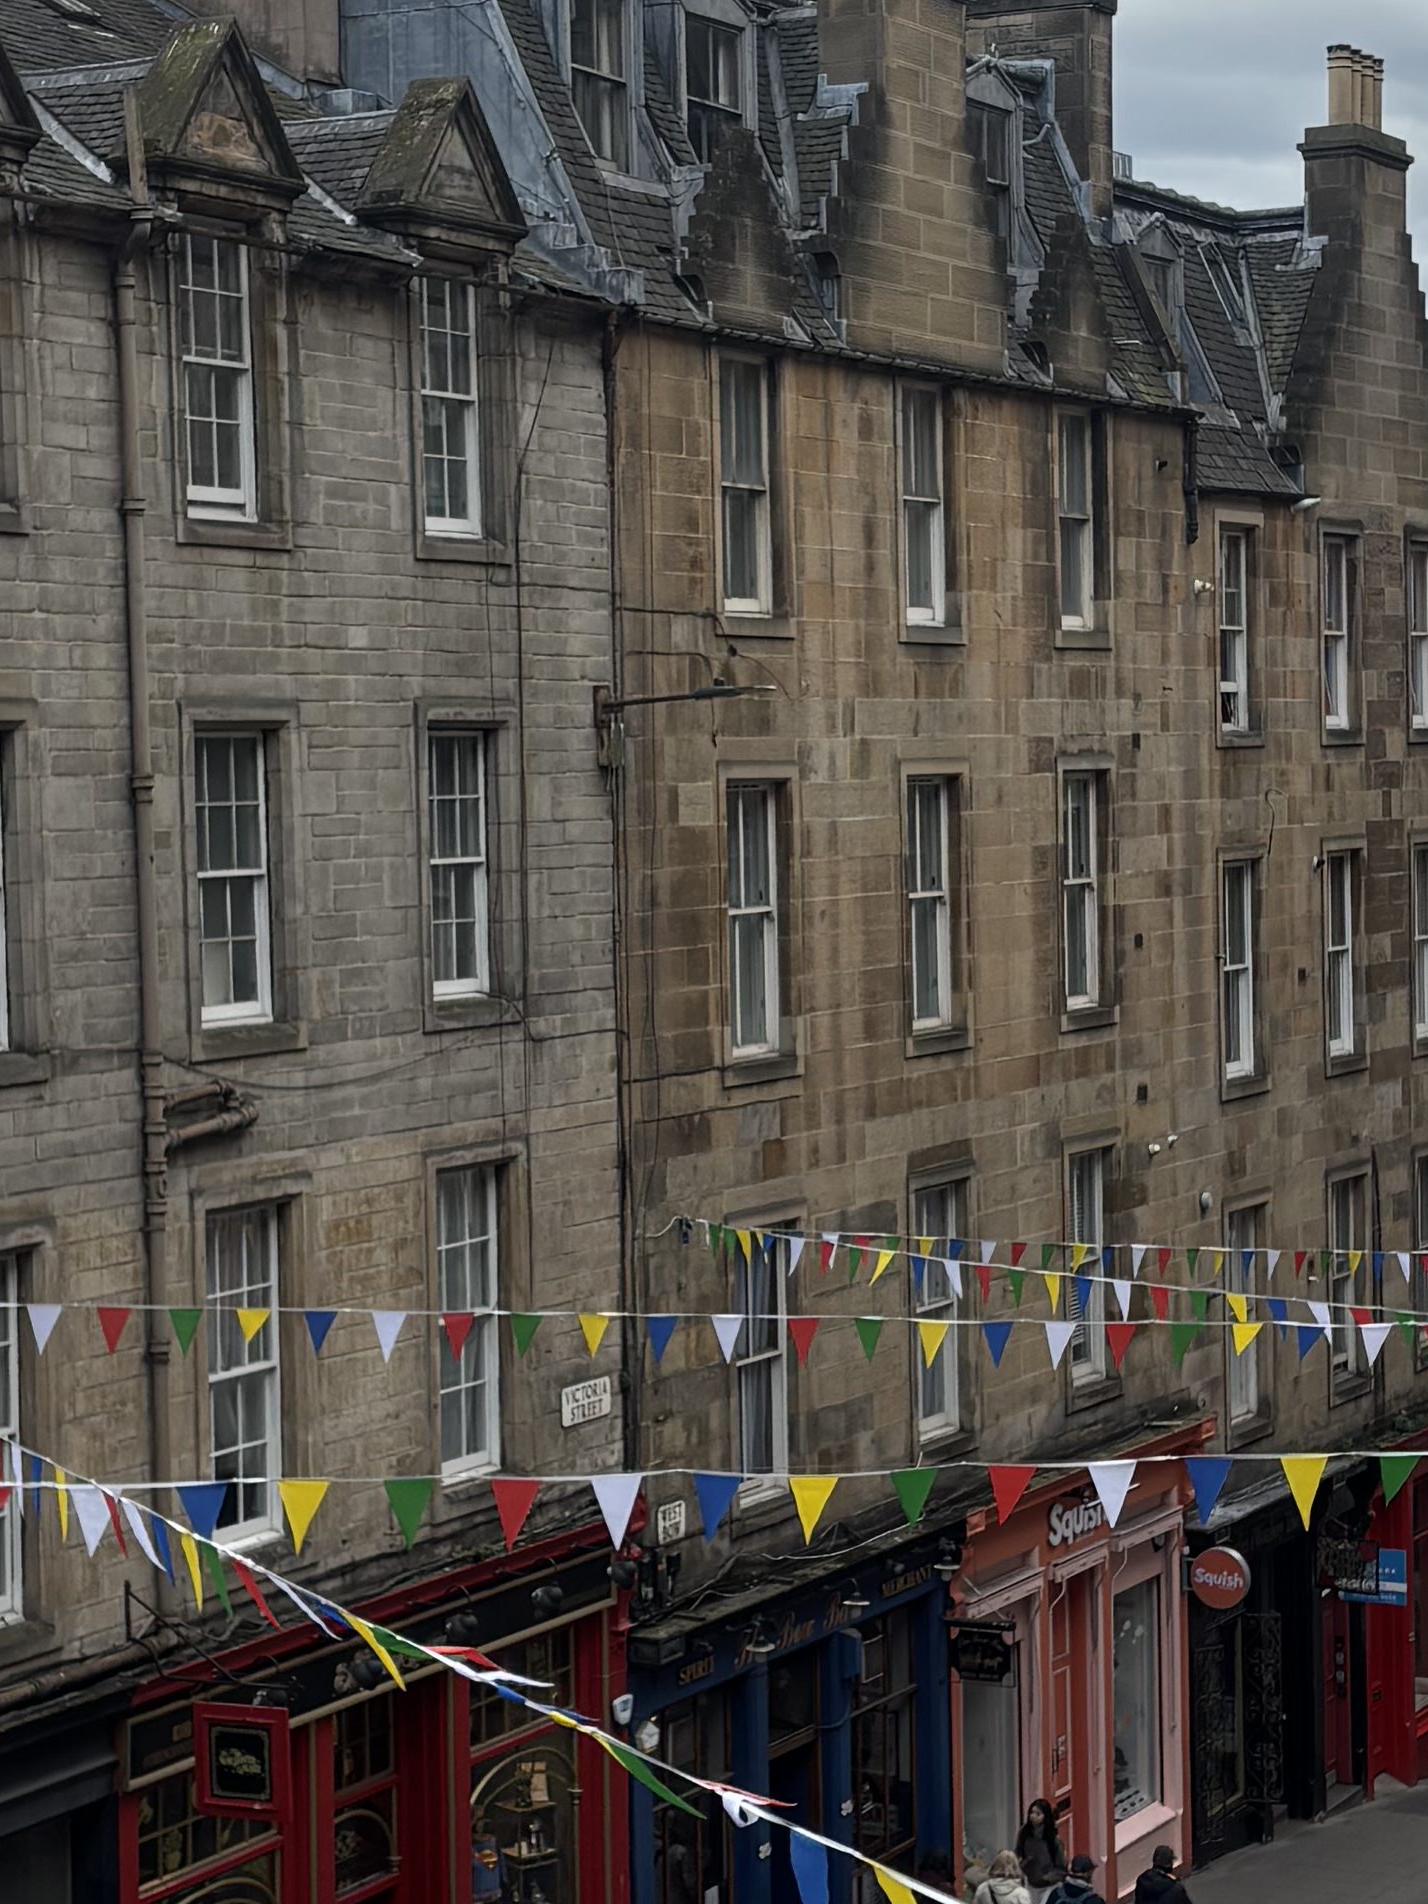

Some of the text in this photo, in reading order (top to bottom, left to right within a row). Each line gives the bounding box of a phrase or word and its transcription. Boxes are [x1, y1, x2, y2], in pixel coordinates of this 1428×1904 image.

[565, 1380, 607, 1406] VICTORIA
[570, 1398, 603, 1422] STREET
[1193, 1567, 1244, 1589] Squish
[677, 1655, 715, 1686] SPIRIT
